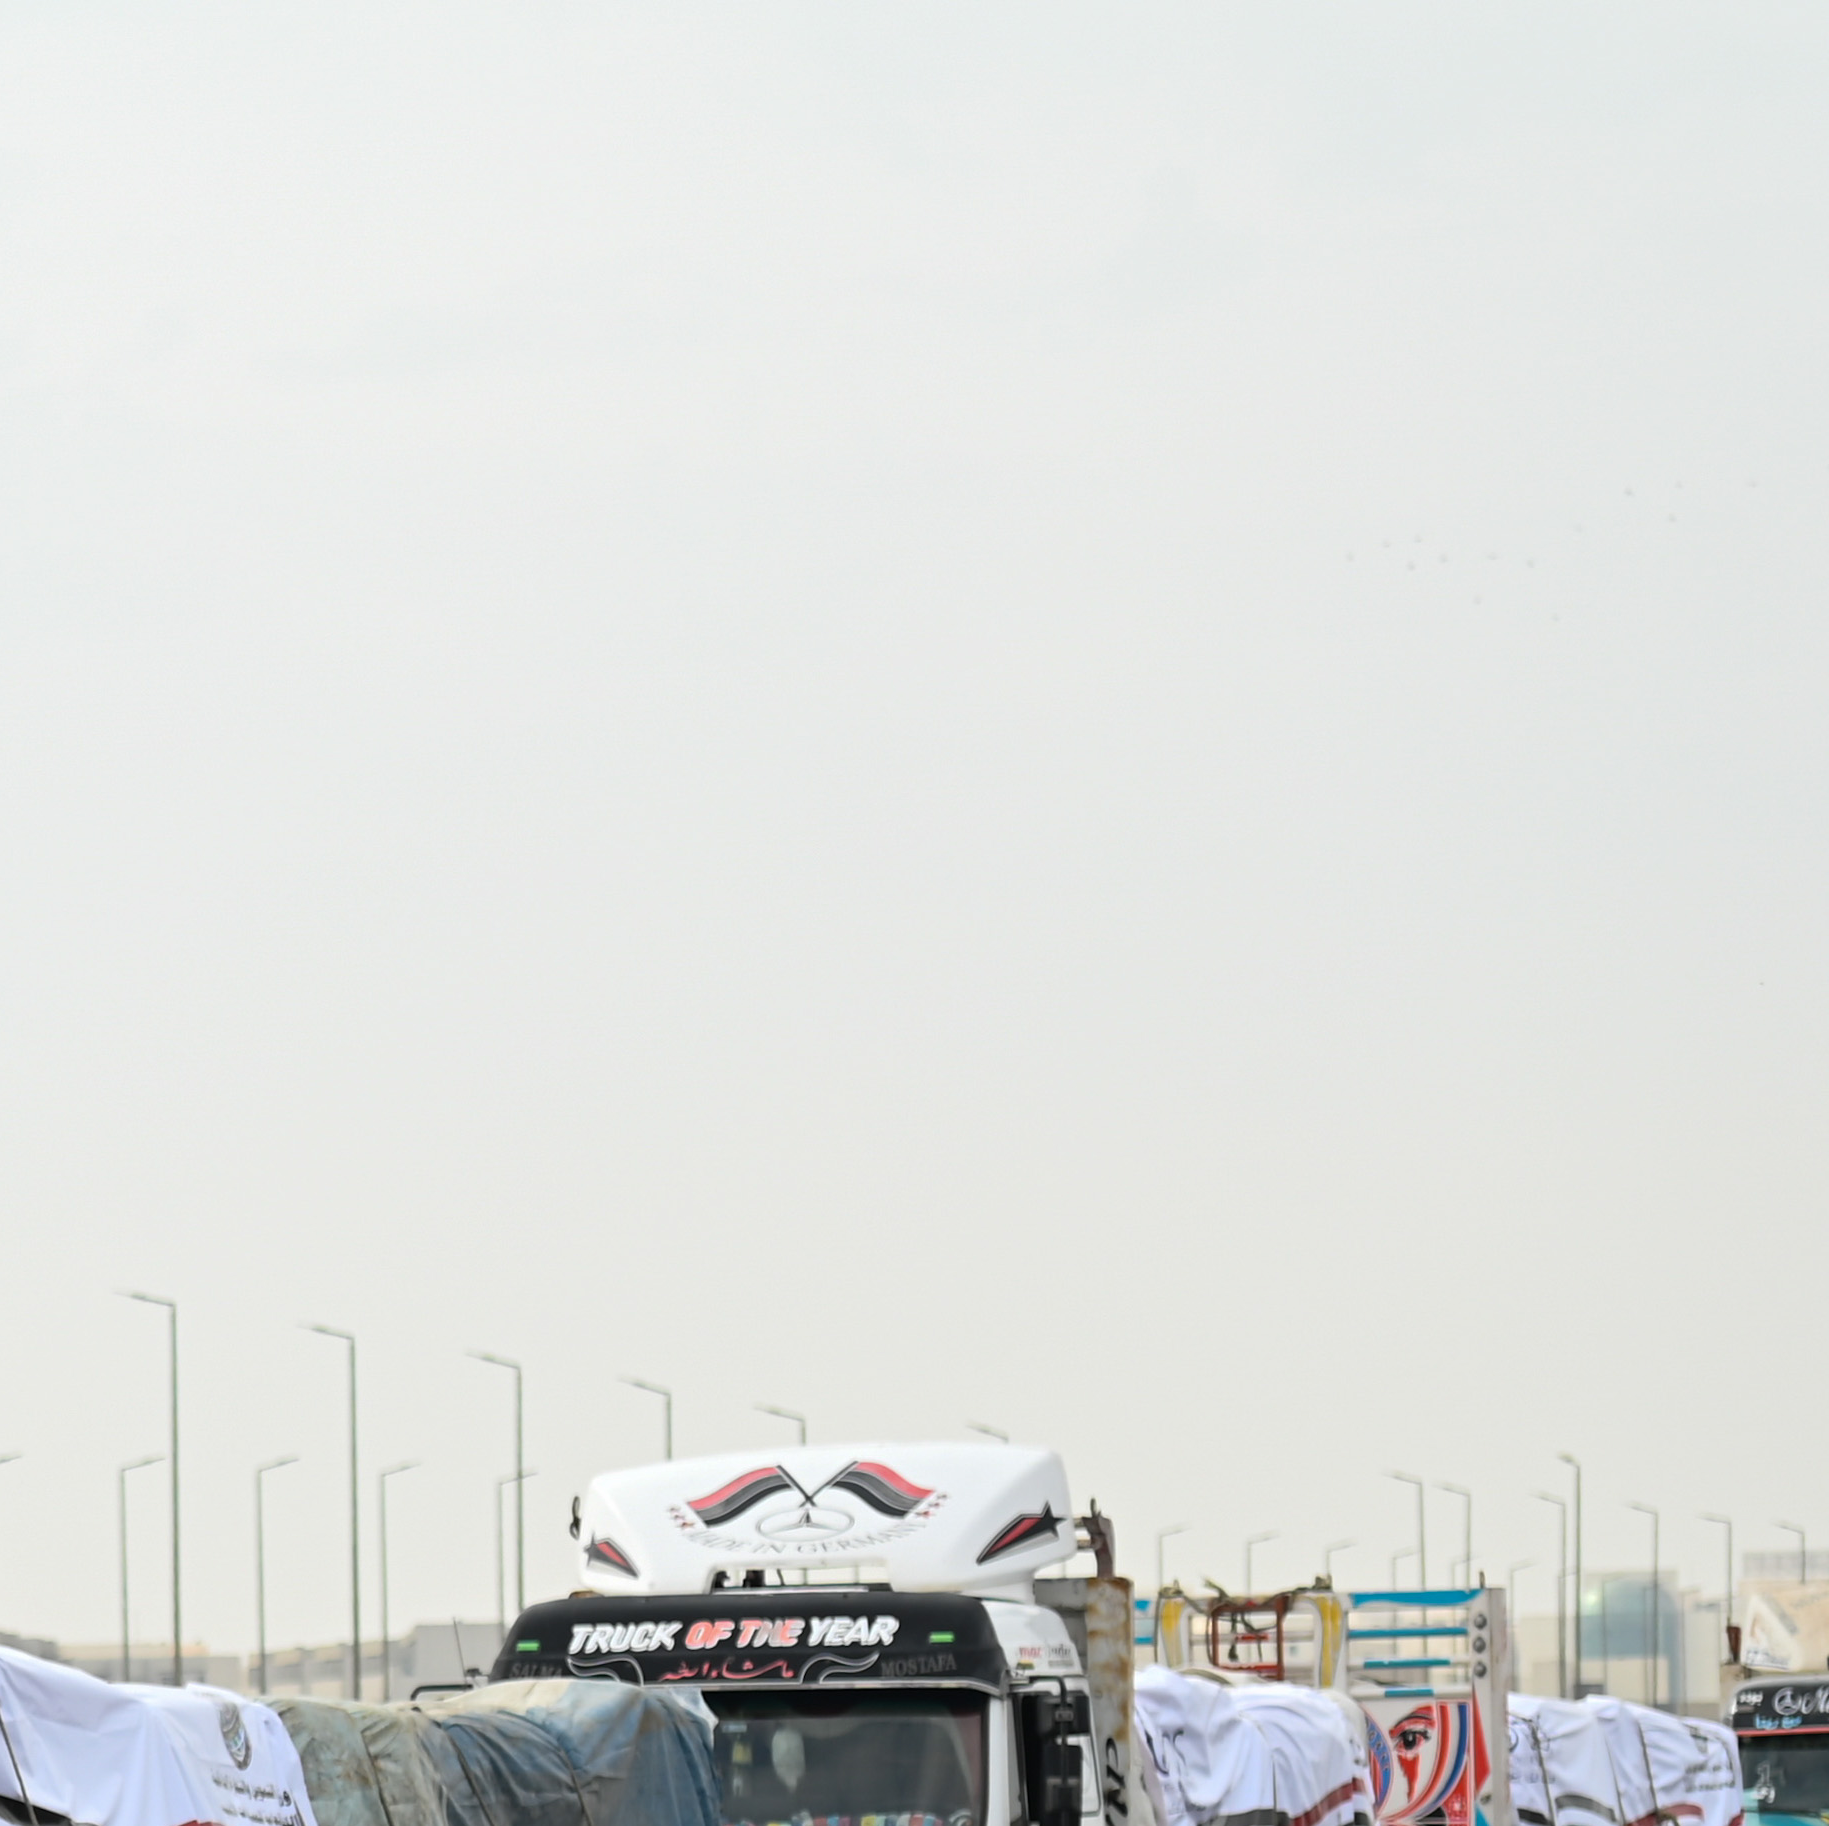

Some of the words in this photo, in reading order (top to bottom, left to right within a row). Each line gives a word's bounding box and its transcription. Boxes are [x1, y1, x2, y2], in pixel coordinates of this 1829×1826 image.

[568, 1622, 682, 1656] TRUCK
[684, 1620, 733, 1650] OF
[737, 1618, 805, 1648] THE
[808, 1615, 900, 1648] YEAR
[880, 1655, 956, 1679] MOSTAFA
